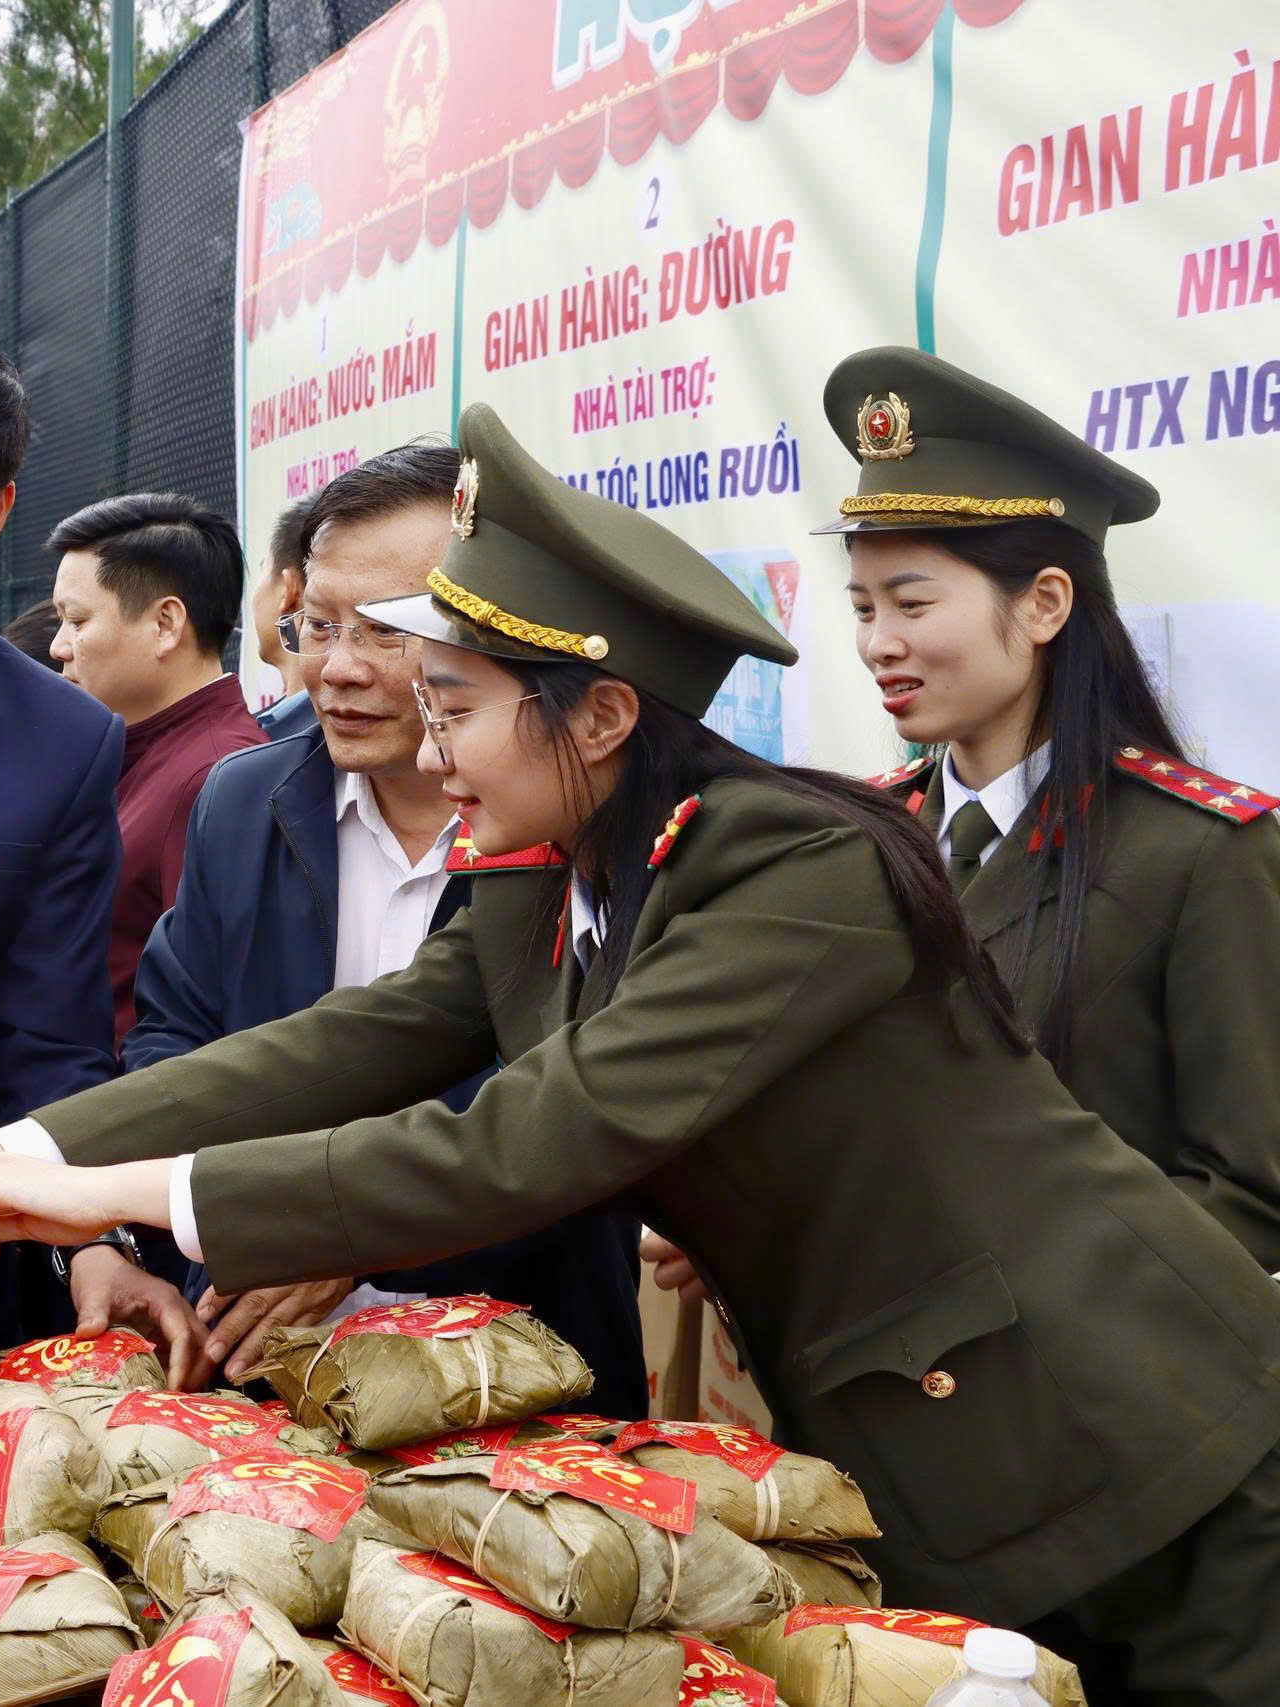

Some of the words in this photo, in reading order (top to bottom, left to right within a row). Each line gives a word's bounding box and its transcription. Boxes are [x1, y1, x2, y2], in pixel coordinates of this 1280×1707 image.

[643, 177, 661, 230] 2
[997, 105, 1143, 237] GIAN
[484, 294, 549, 374] GIAN
[559, 264, 649, 353] HÀNG:
[659, 217, 796, 324] ĐƯỜNG
[1177, 218, 1280, 318] NHÀ
[250, 395, 276, 450] GIAN
[279, 375, 323, 438] HÀNG:
[327, 347, 376, 421] NƯỚC
[382, 317, 437, 403] MẮM
[572, 374, 618, 435] NHÀ
[623, 366, 658, 423] TÀI
[662, 356, 715, 419] TRỢ:
[1084, 376, 1190, 454] HTX
[646, 450, 709, 509] LONG
[718, 421, 801, 499] RUỒI
